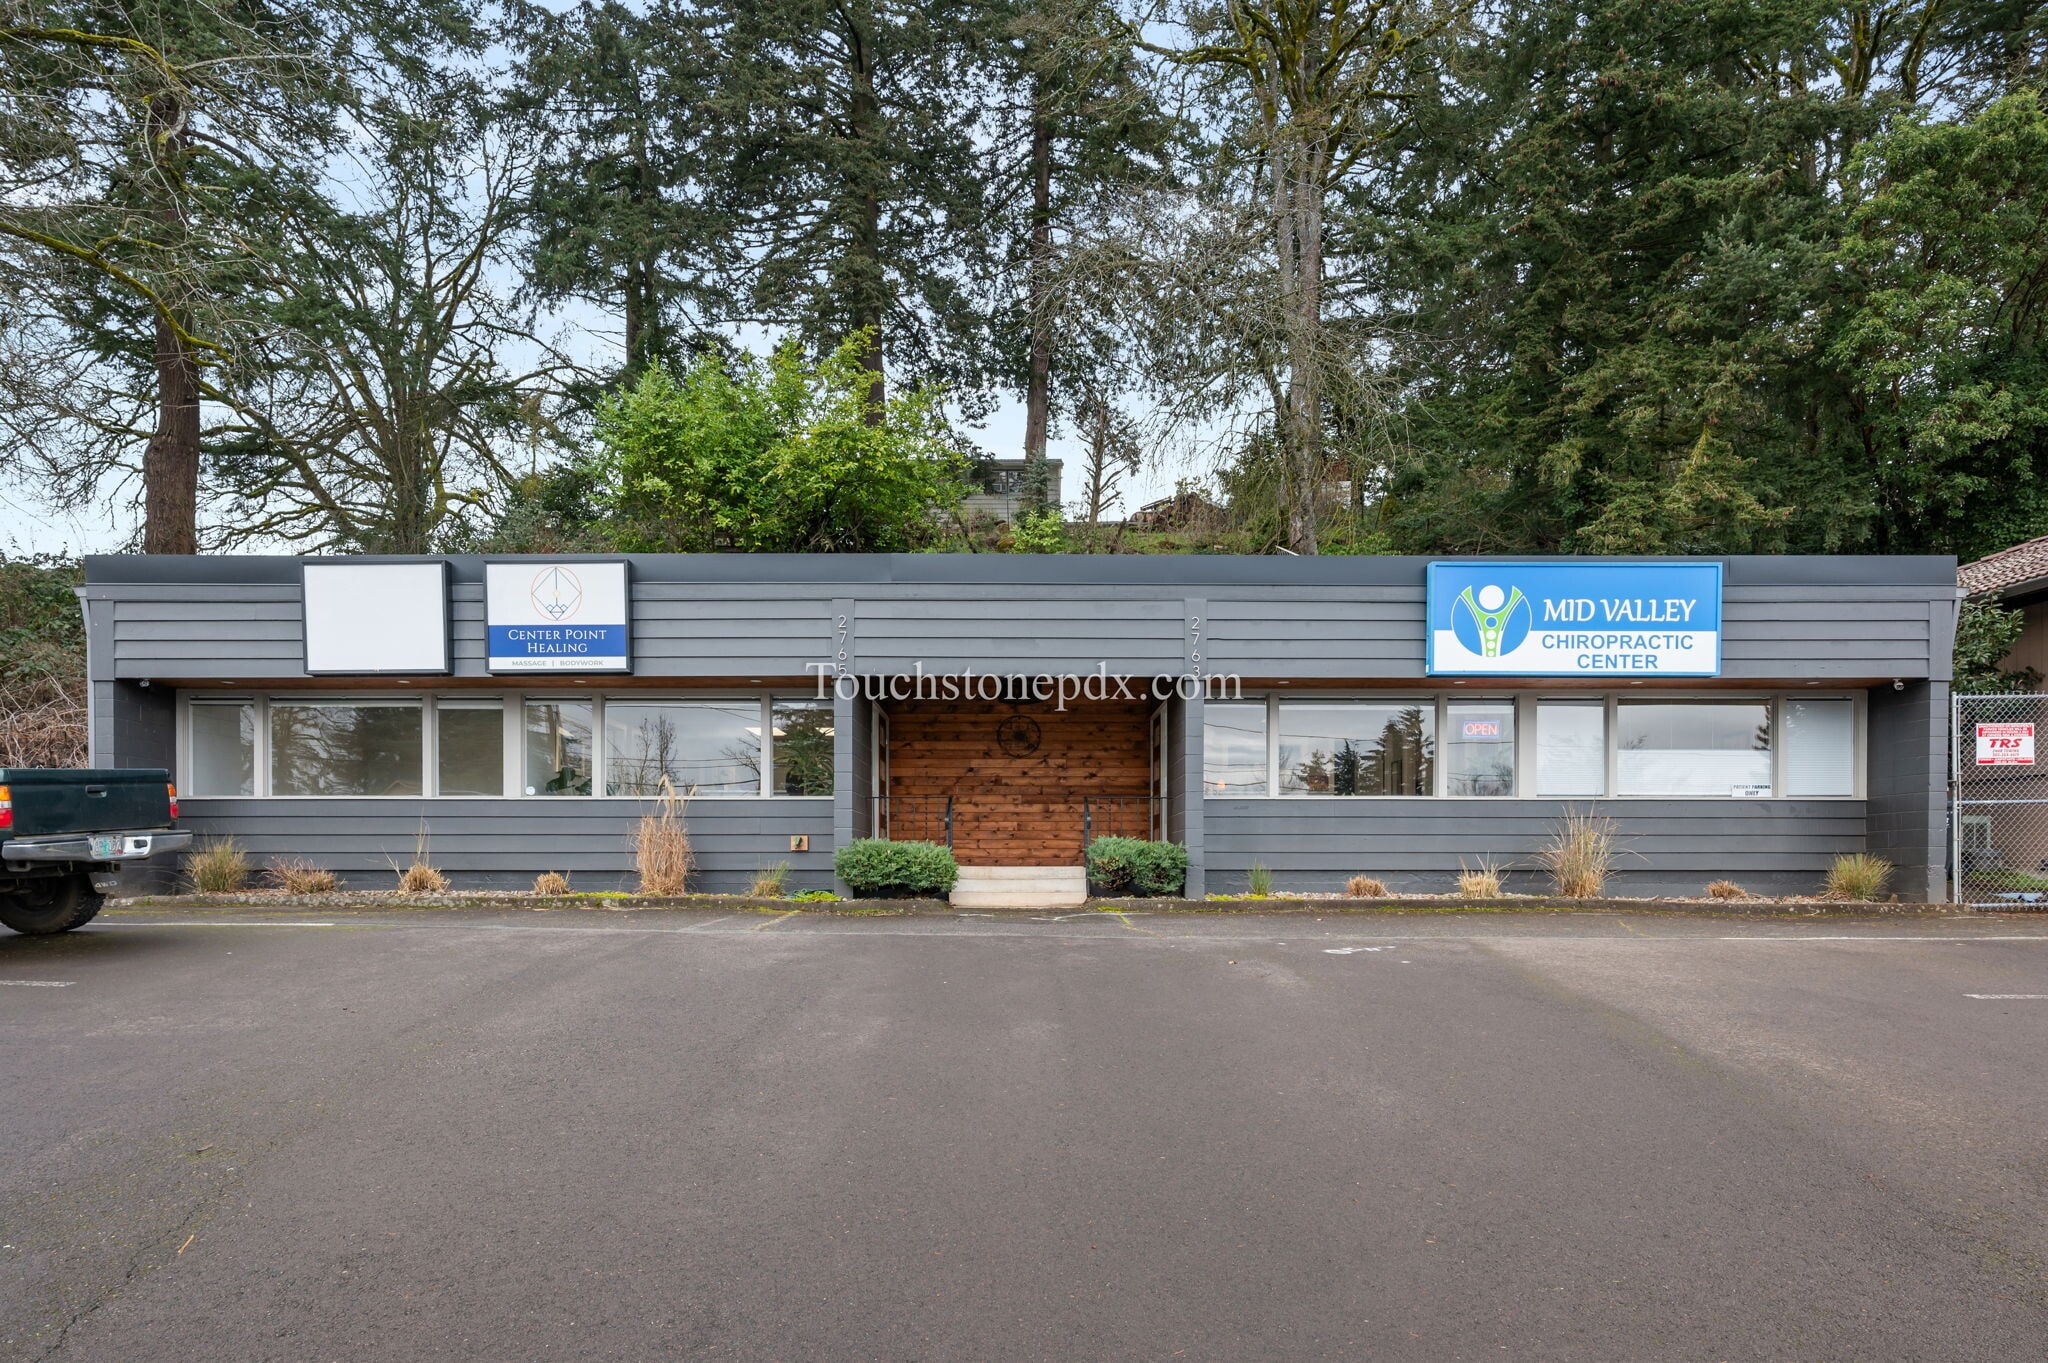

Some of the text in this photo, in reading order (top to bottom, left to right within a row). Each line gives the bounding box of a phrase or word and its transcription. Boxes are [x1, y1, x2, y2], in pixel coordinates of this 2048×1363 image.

[1543, 598, 1696, 622] MID VALLEY
[838, 615, 847, 676] 2765
[1541, 634, 1693, 650] CHIROPRACTIC
[1577, 654, 1658, 669] CENTER
[1464, 722, 1498, 736] OPEN
[1989, 738, 2022, 748] TRS
